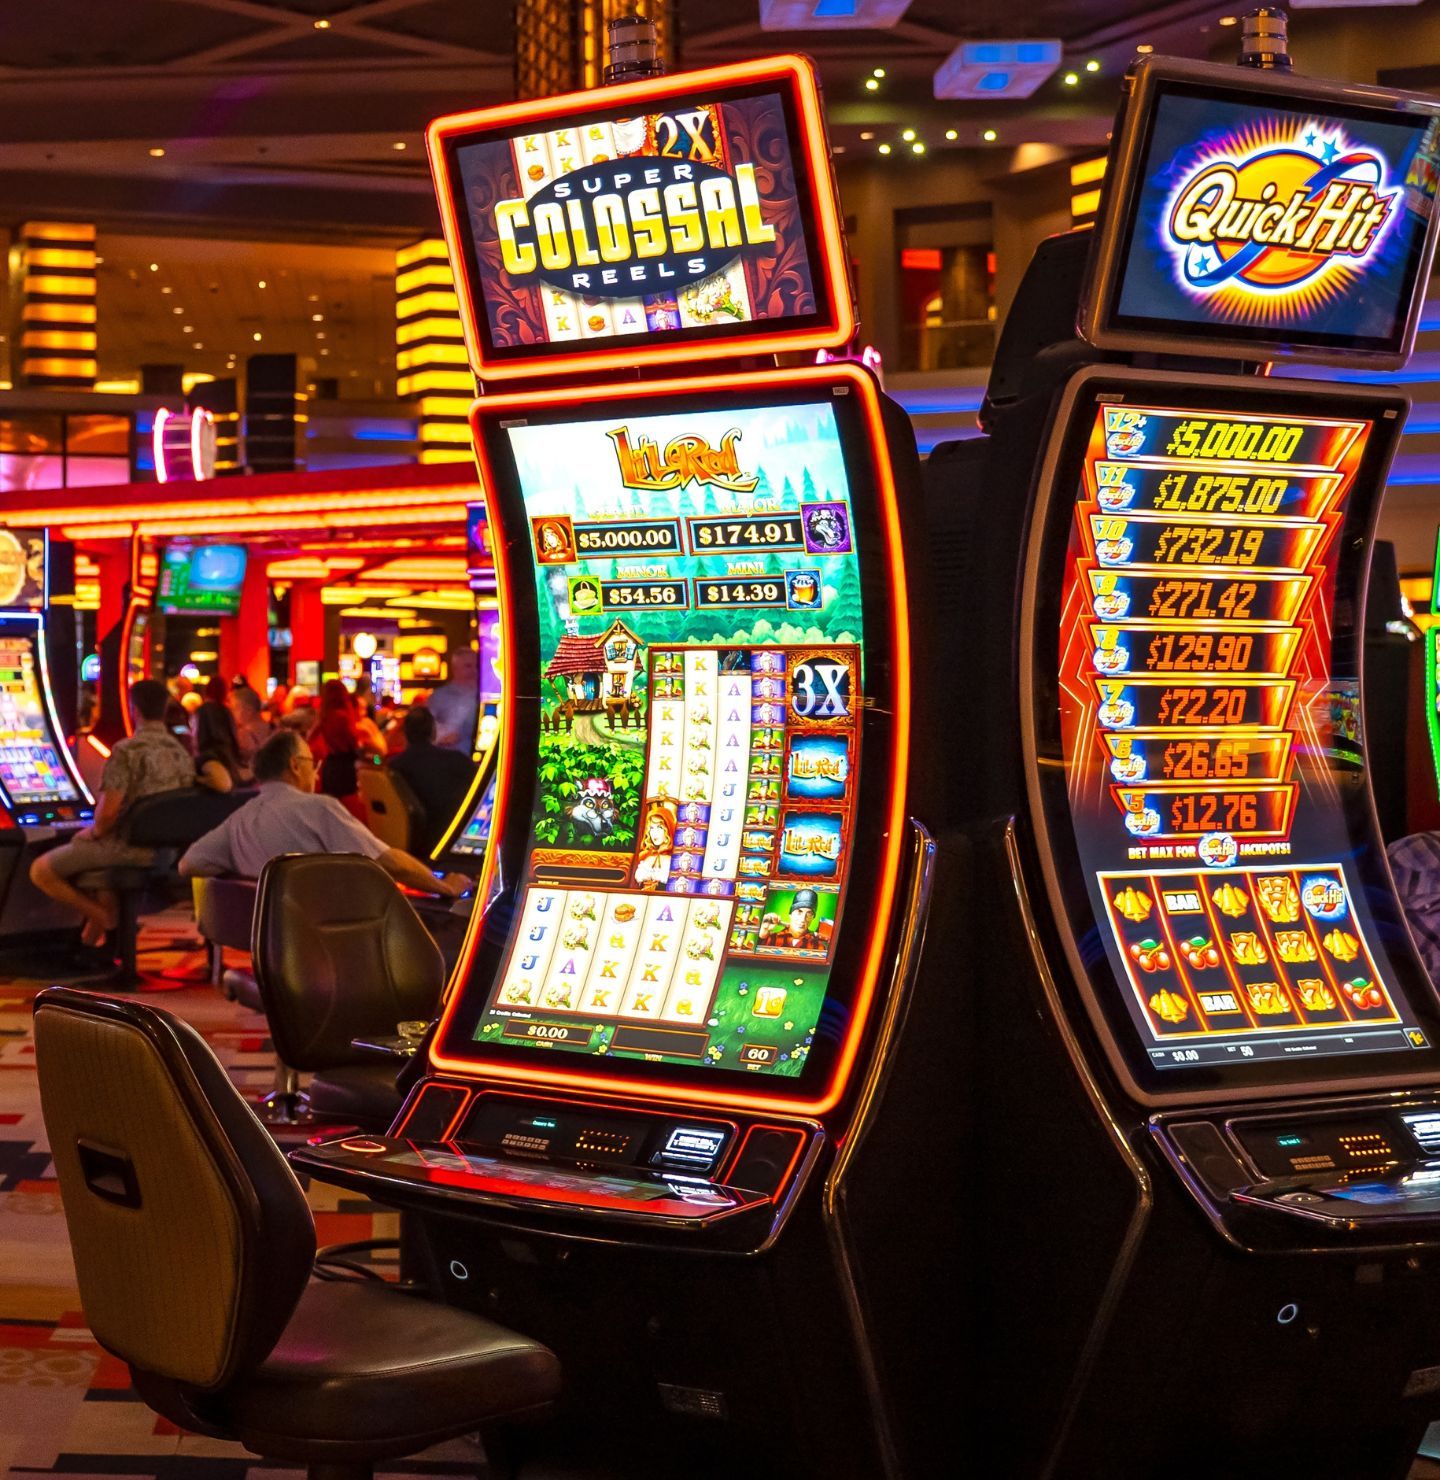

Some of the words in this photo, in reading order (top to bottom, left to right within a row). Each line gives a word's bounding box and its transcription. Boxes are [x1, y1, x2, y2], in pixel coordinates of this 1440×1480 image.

[524, 136, 539, 152] K
[557, 131, 571, 147] K
[655, 110, 718, 163] 2X
[553, 164, 694, 198] SUPER
[494, 162, 776, 275] COLOSSAL
[1172, 167, 1313, 245] Quick
[1298, 180, 1392, 253] Hit
[572, 257, 707, 289] REELS
[557, 315, 572, 332] K
[1108, 411, 1147, 432] 12+
[1167, 420, 1304, 462] $5,000.00
[1101, 467, 1128, 487] 11
[1155, 474, 1289, 513] $1,875.00
[698, 523, 796, 547] $174.91
[1095, 519, 1128, 540] 10
[579, 529, 672, 549] $5,000.00
[1154, 527, 1264, 564] $732.19
[616, 565, 667, 579] MINOR
[726, 561, 765, 576] MINI
[609, 587, 676, 605] $54.56
[707, 584, 778, 602] $14.39
[1149, 581, 1257, 618] $271.42
[1146, 635, 1253, 671] $129.90
[694, 658, 708, 671] K
[694, 682, 708, 695] K
[728, 683, 741, 696] A
[791, 664, 850, 717] 3X
[1107, 684, 1125, 705] 7
[662, 708, 674, 721] K
[727, 709, 741, 722] A
[1158, 689, 1247, 725] $72.20
[661, 733, 674, 746] K
[726, 735, 739, 748] A
[659, 758, 672, 771] K
[724, 760, 738, 772] A
[1163, 742, 1249, 779] $26.65
[722, 784, 736, 797] J
[1129, 793, 1145, 813] 5
[720, 809, 734, 822] J
[1171, 795, 1257, 831] $12.76
[717, 833, 731, 847] J
[1128, 847, 1147, 859] BET
[1150, 847, 1174, 859] MAX
[1176, 846, 1196, 858] FOR
[1240, 843, 1291, 856] JACKPOTS!
[713, 858, 728, 872] J
[536, 897, 555, 912] J
[1164, 894, 1200, 912] BAR
[656, 904, 674, 922] A
[529, 926, 548, 941] J
[649, 934, 668, 952] K
[521, 955, 540, 970] J
[560, 958, 577, 974] A
[600, 960, 617, 978] K
[641, 963, 659, 982] K
[591, 989, 608, 1007] K
[632, 993, 650, 1011] K
[1201, 994, 1235, 1012] BAR
[527, 1025, 568, 1039] $0.00
[645, 1053, 663, 1061] WIN
[747, 1048, 768, 1060] 60
[1172, 1050, 1199, 1062] $0.00
[1240, 1046, 1254, 1056] 50
